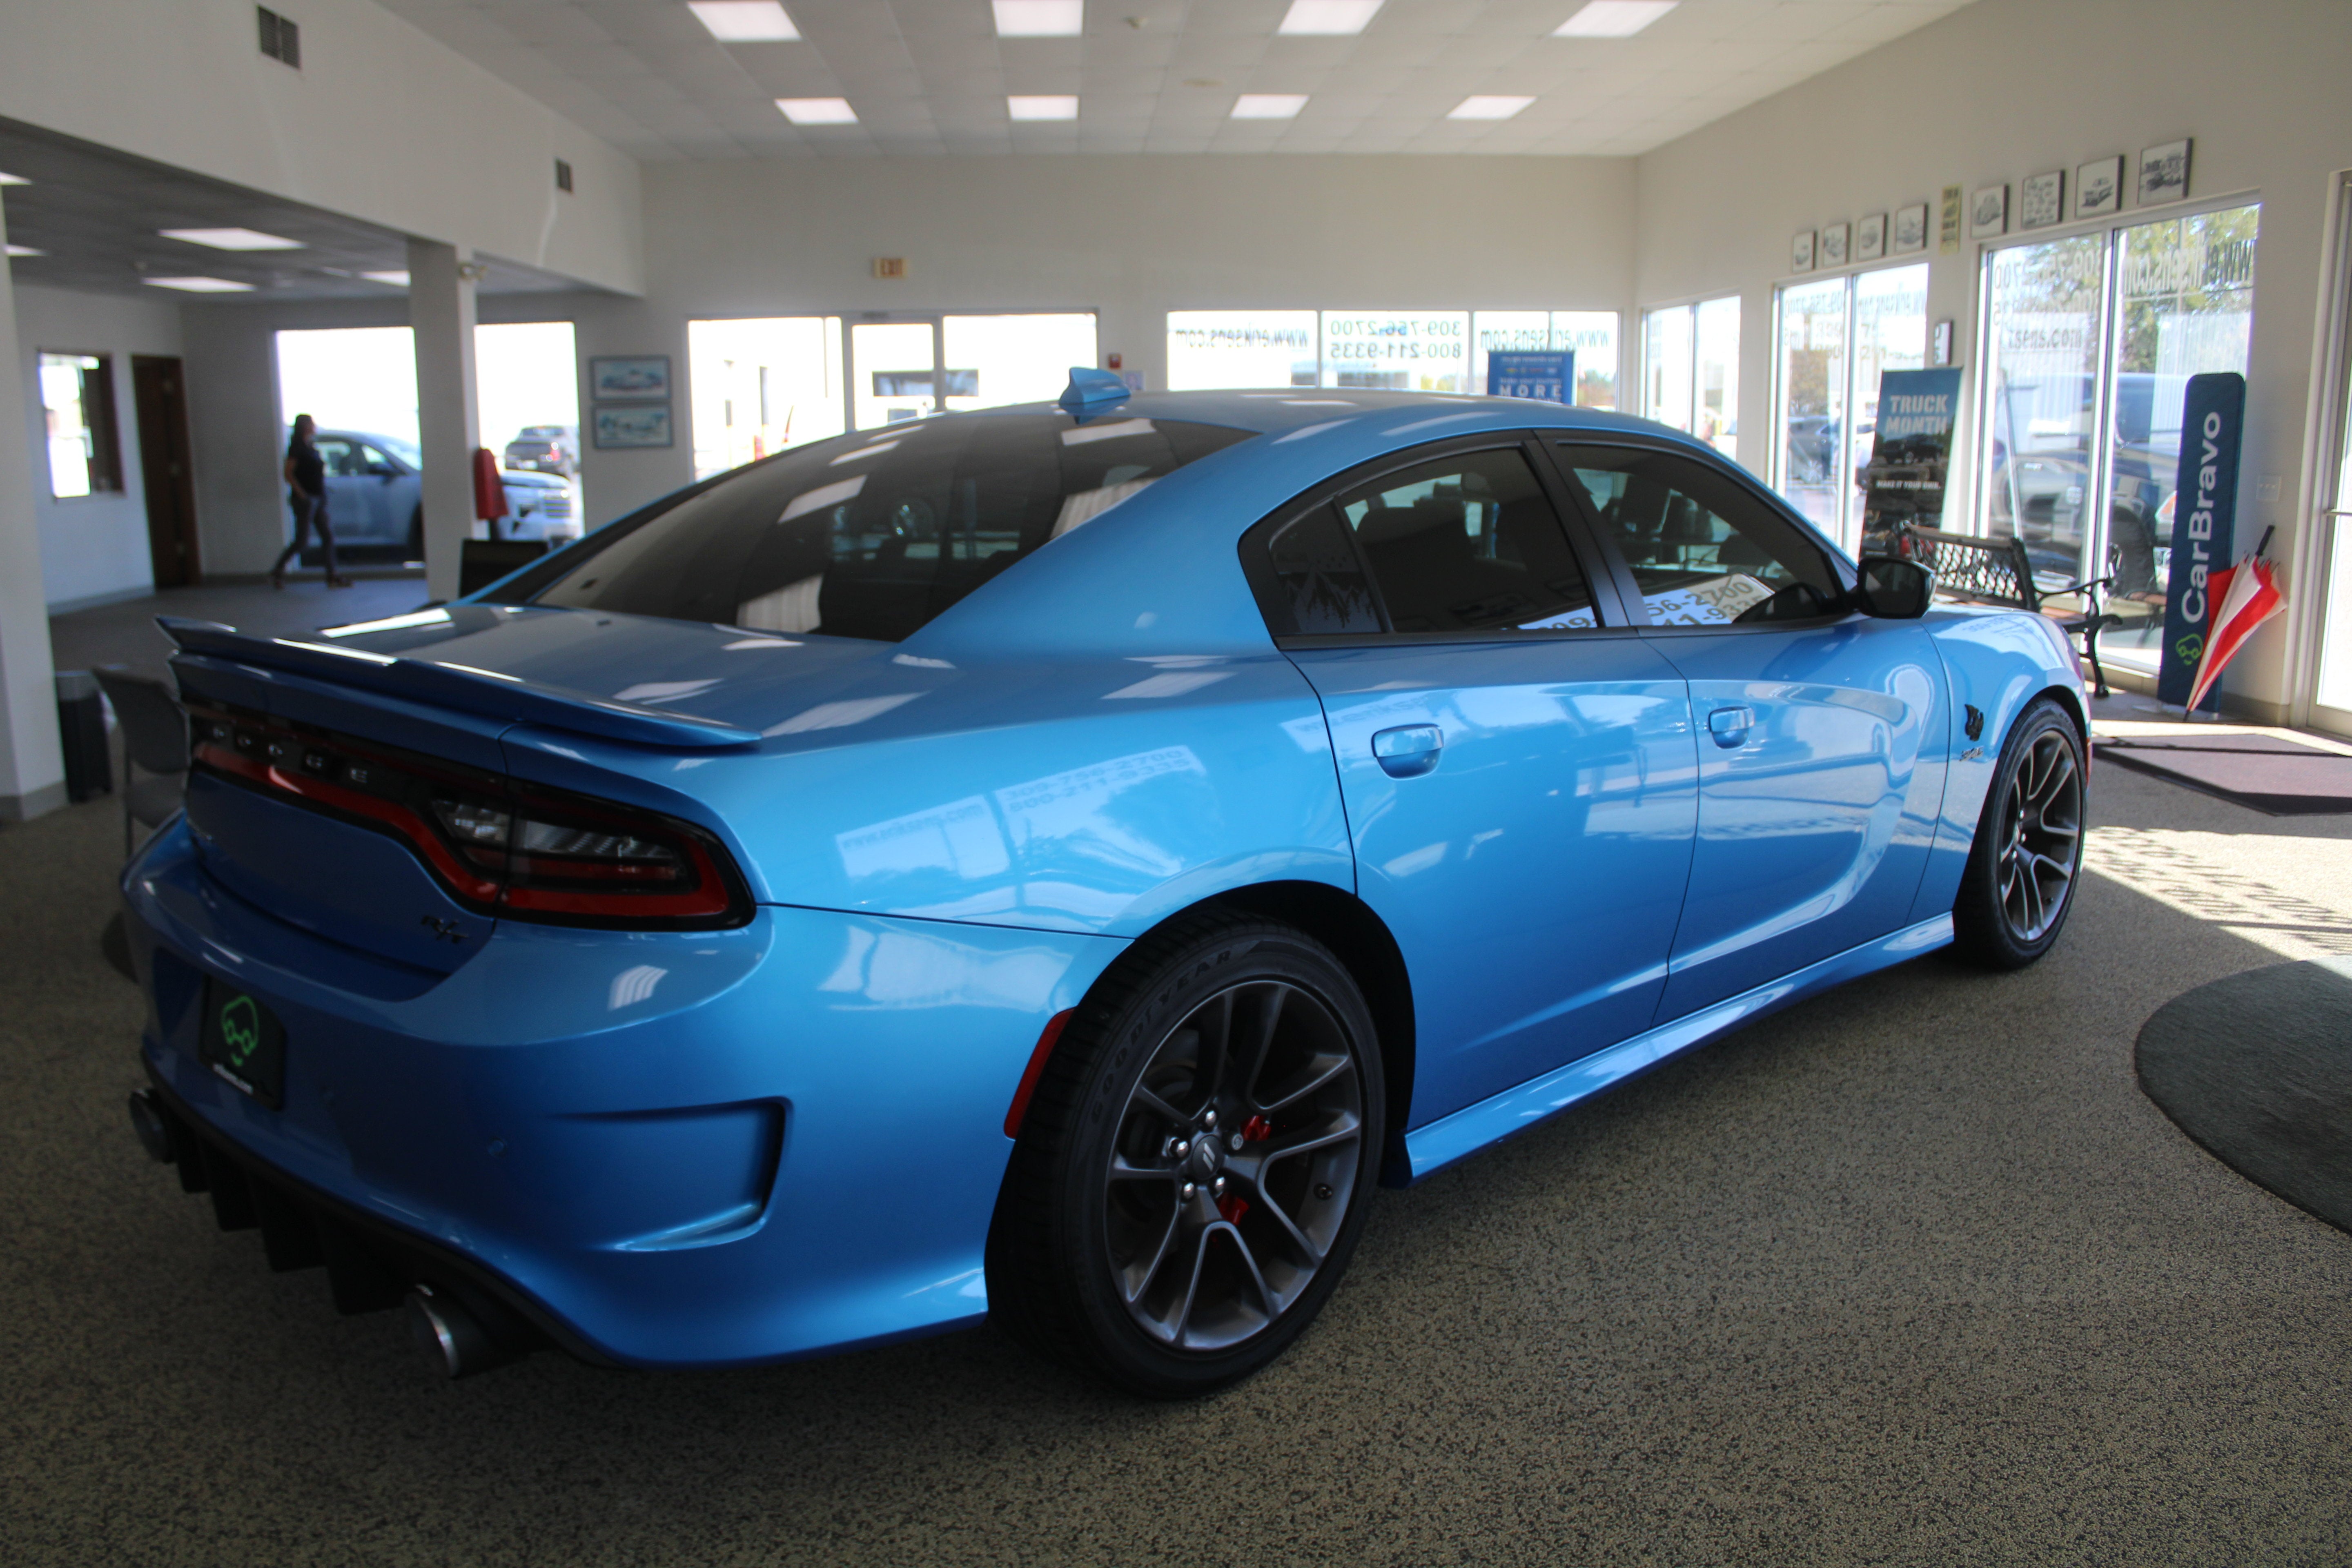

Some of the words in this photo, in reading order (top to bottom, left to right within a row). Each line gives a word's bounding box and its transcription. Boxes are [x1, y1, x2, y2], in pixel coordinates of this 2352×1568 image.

[1499, 384, 1561, 398] MORE
[1889, 394, 1949, 414] TRUCK
[1885, 416, 1947, 435] MONTH
[1875, 480, 1895, 488] MAKE
[1903, 480, 1922, 488] YOUR
[2181, 411, 2221, 624] CarBravo
[421, 915, 470, 944] R/T
[1090, 950, 1231, 1125] GOODYEAR
